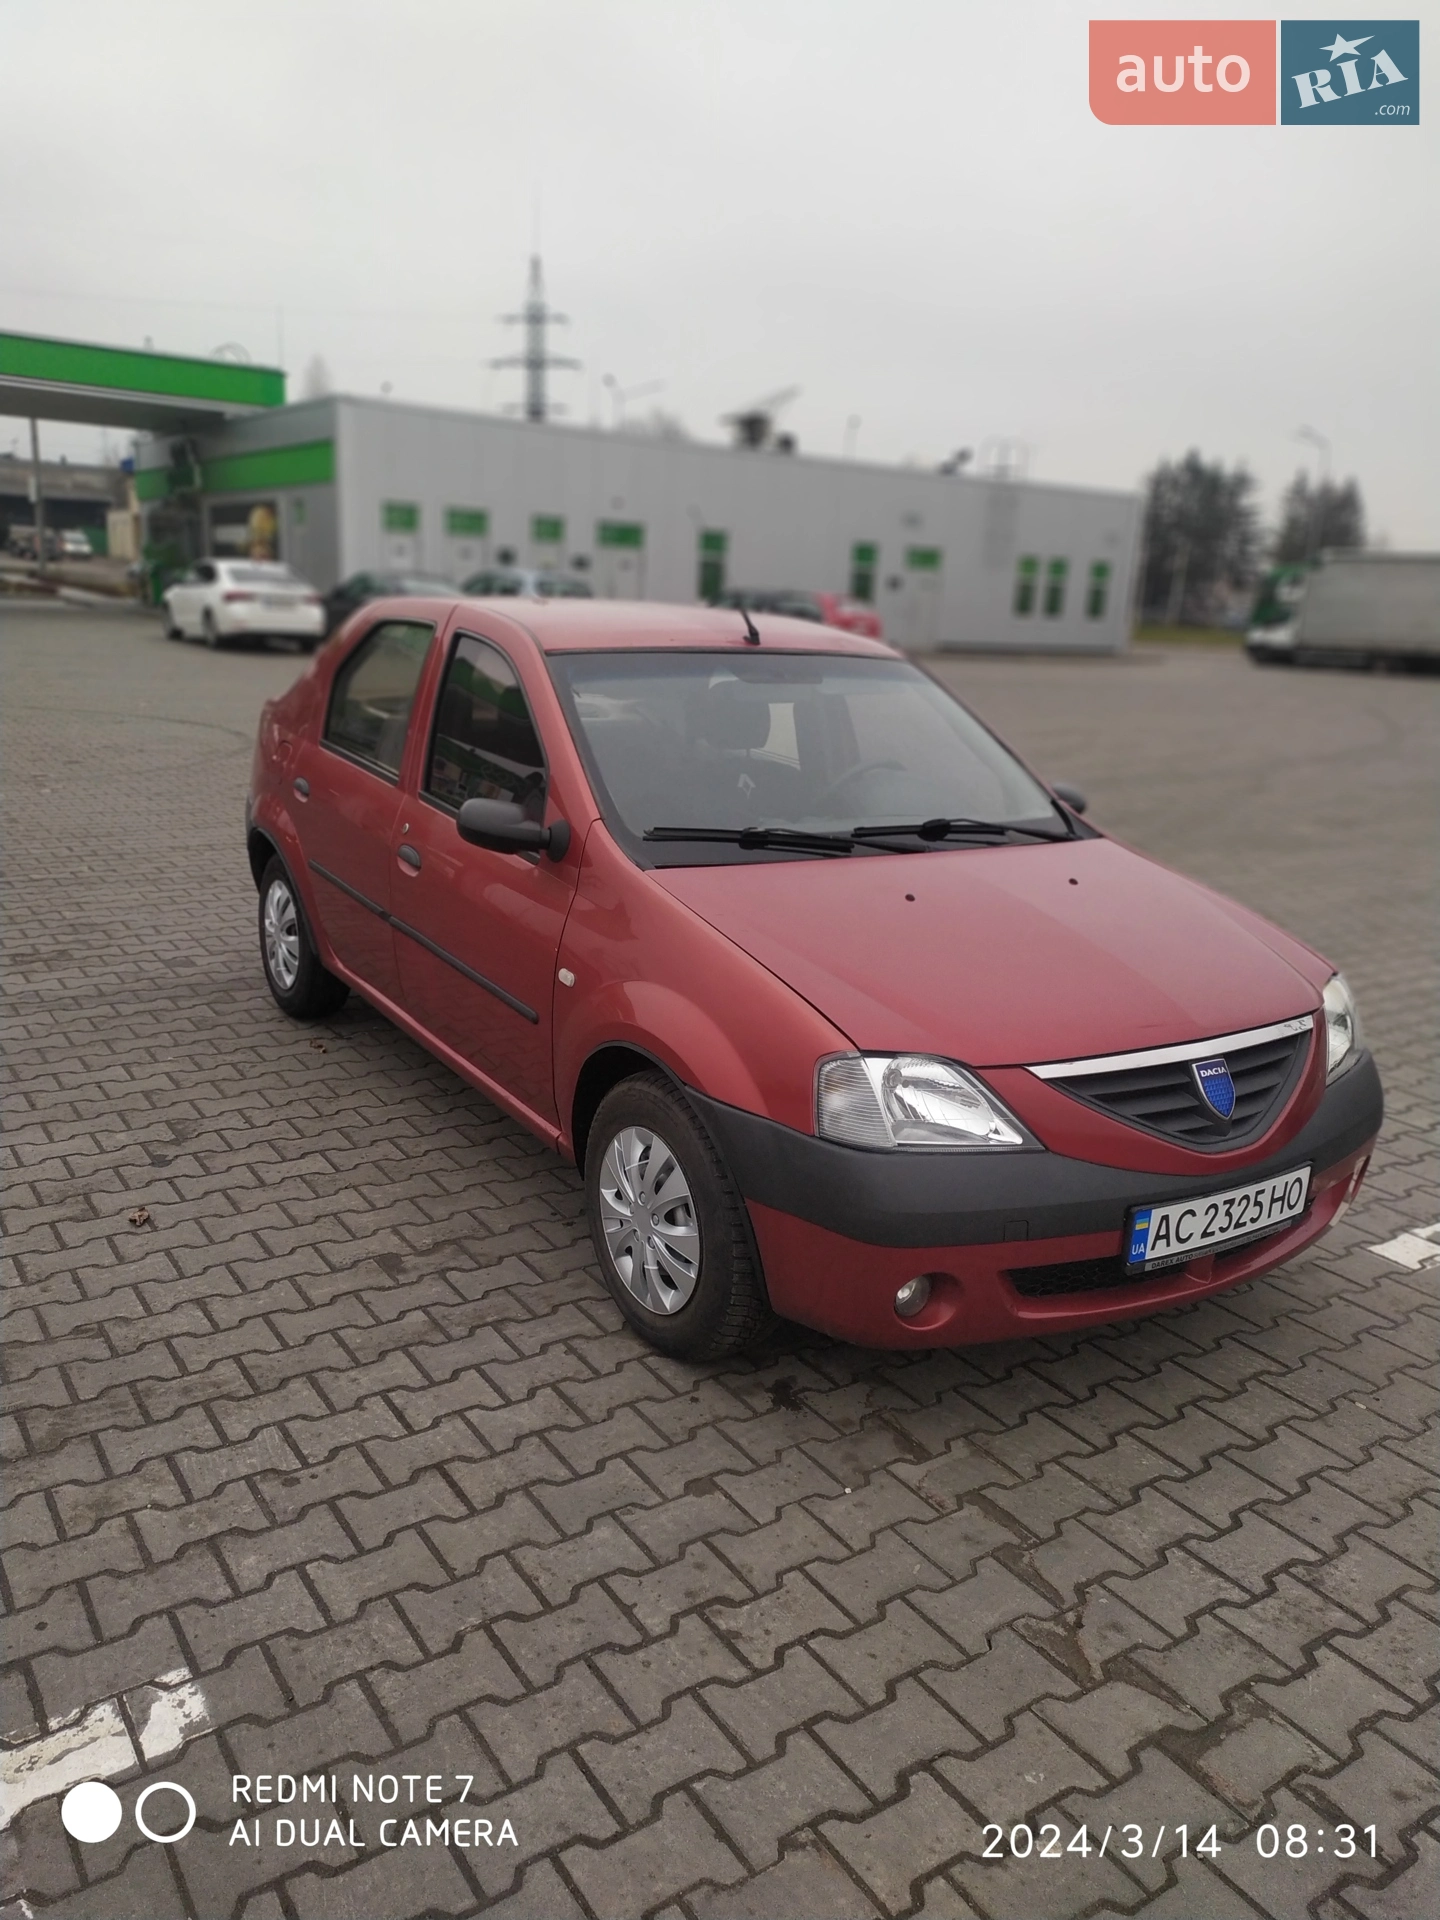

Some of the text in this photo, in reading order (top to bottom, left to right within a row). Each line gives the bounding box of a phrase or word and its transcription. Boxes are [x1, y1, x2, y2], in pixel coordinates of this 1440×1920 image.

[1199, 1066, 1227, 1078] DACIA
[1150, 1208, 1197, 1252] AC
[1200, 1188, 1266, 1240] 2325
[1267, 1176, 1303, 1219] HO
[1131, 1242, 1145, 1255] UA
